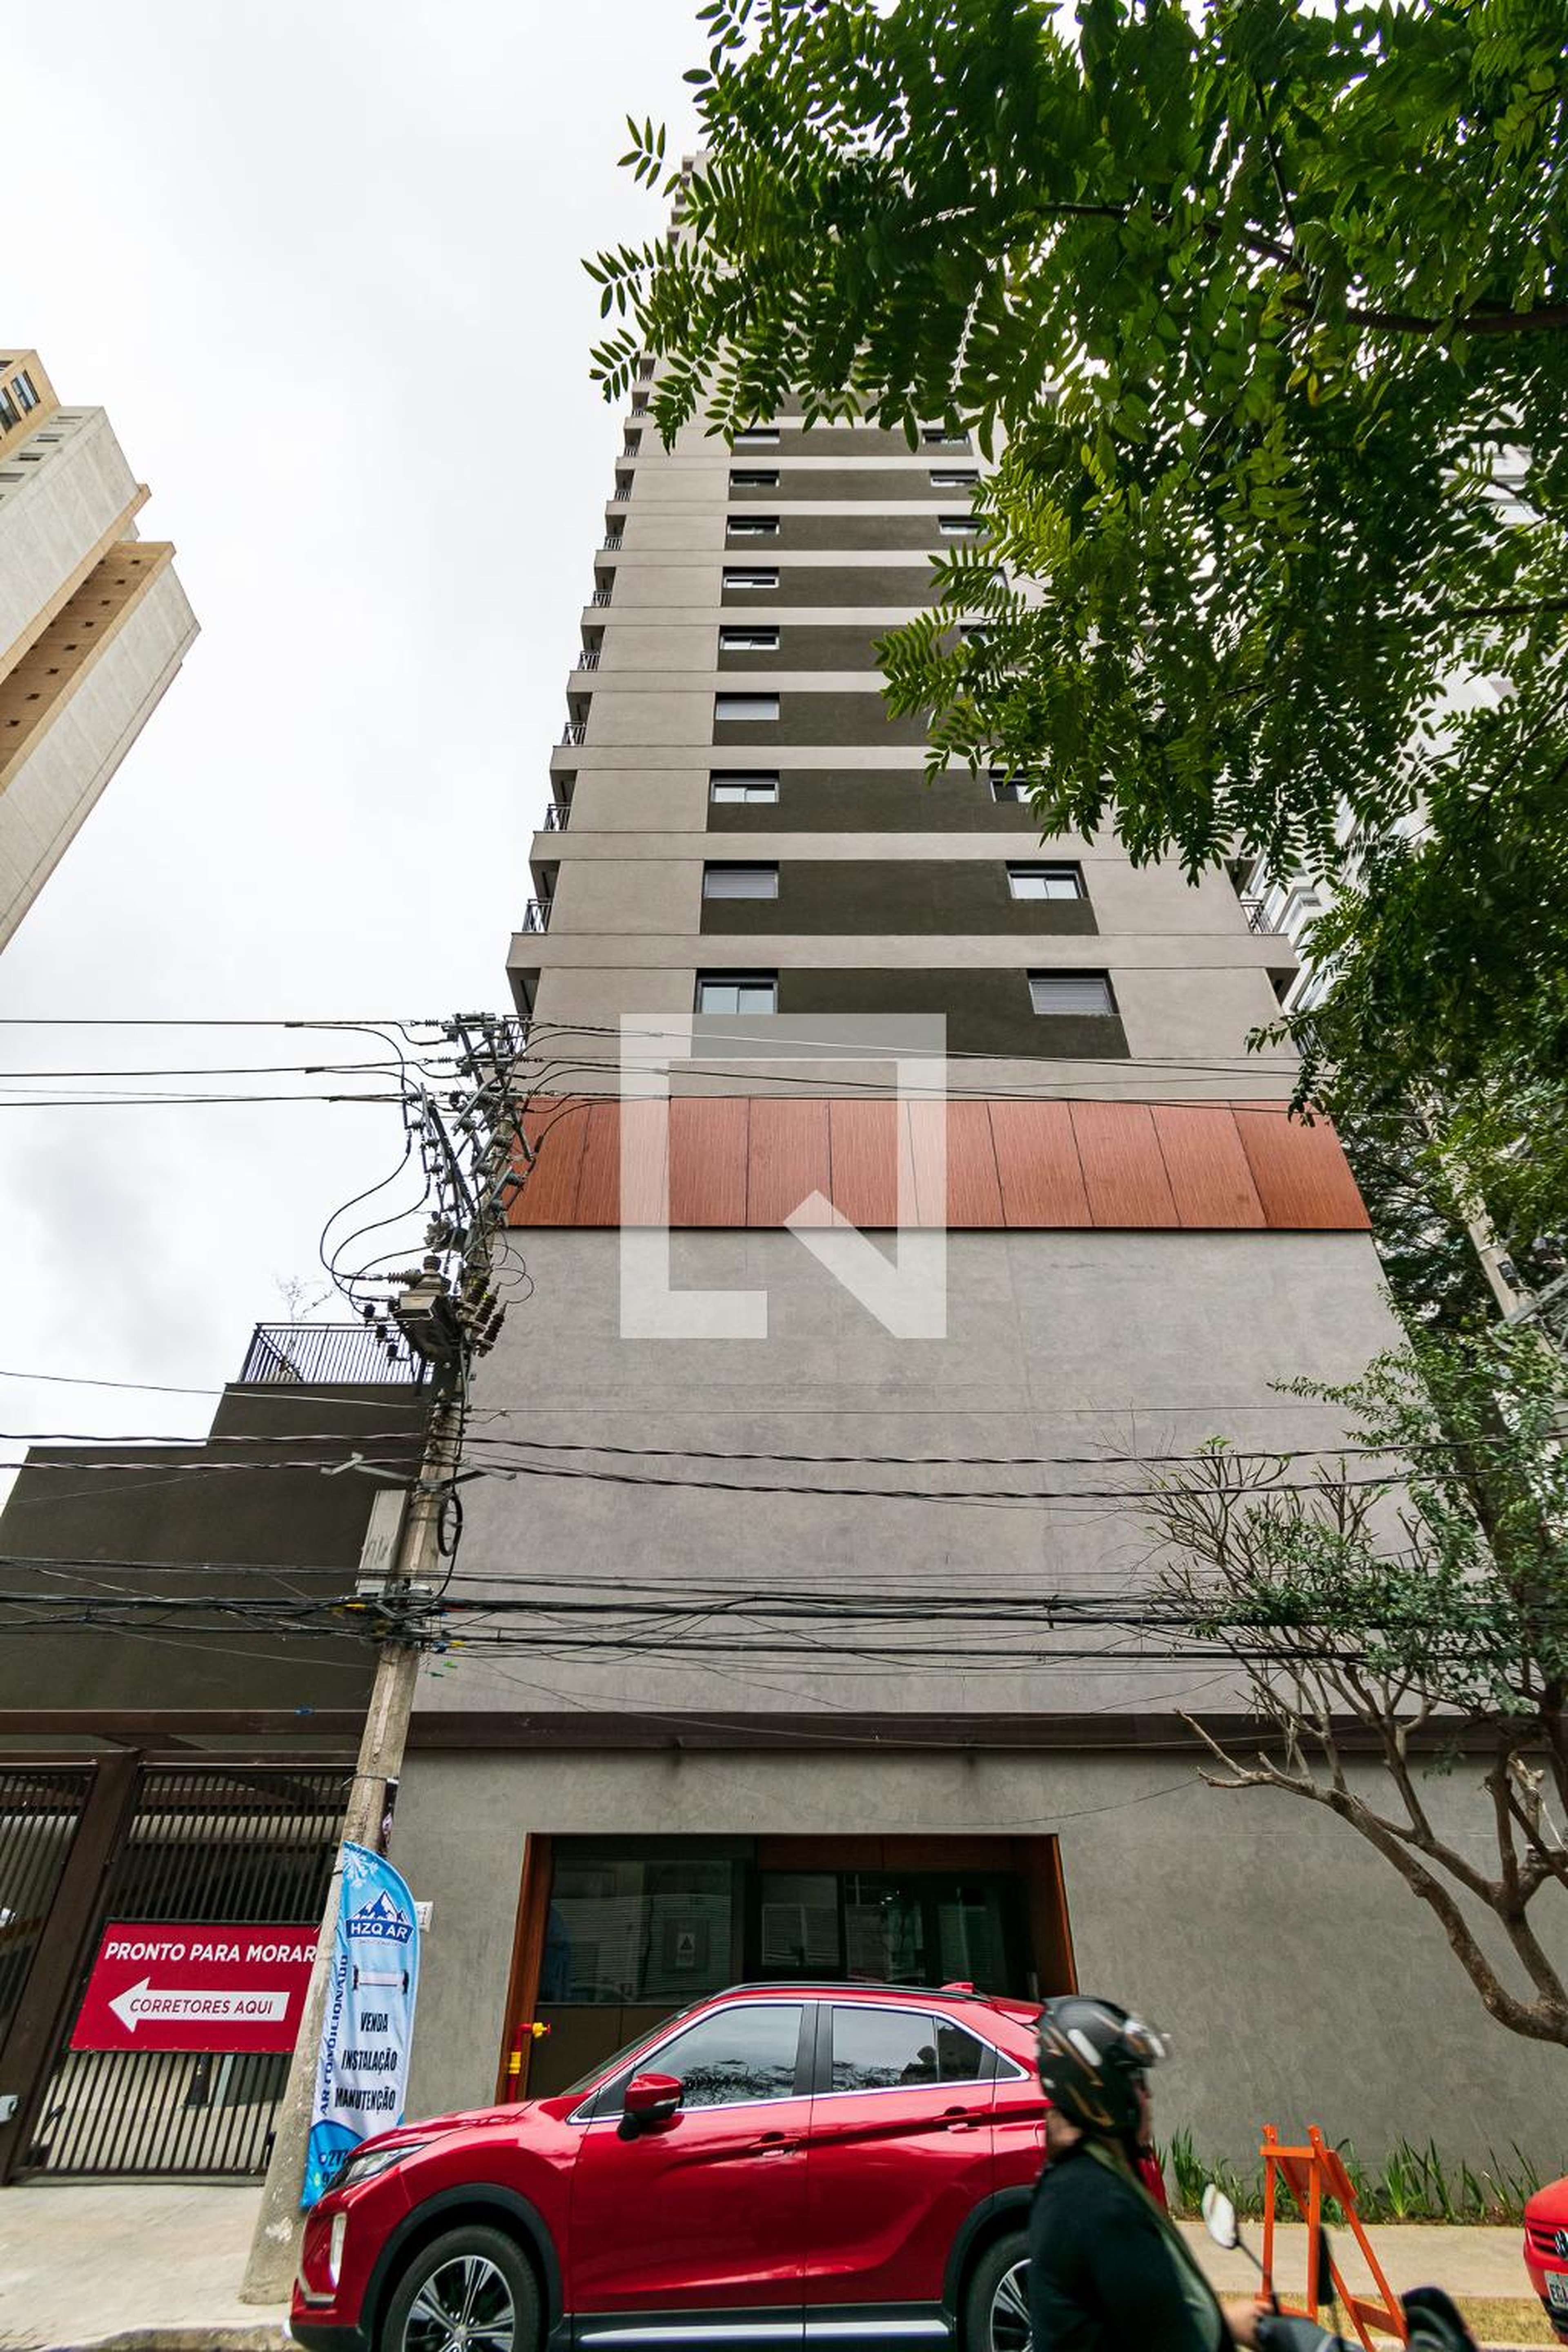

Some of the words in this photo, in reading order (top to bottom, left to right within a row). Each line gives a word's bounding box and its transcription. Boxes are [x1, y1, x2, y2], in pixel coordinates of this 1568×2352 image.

[350, 1922, 383, 1936] HZQ
[385, 1924, 408, 1938] AR
[105, 1942, 185, 1960] PRONTO
[189, 1944, 240, 1962] PARA
[246, 1945, 318, 1962] MORAR
[129, 1999, 230, 2014] CORRETORES
[234, 2000, 274, 2015] AQUI
[360, 2012, 388, 2032] VENDA
[341, 2047, 398, 2075] INSTALAÇÃO
[334, 2085, 396, 2115] MANUTENÇÃO
